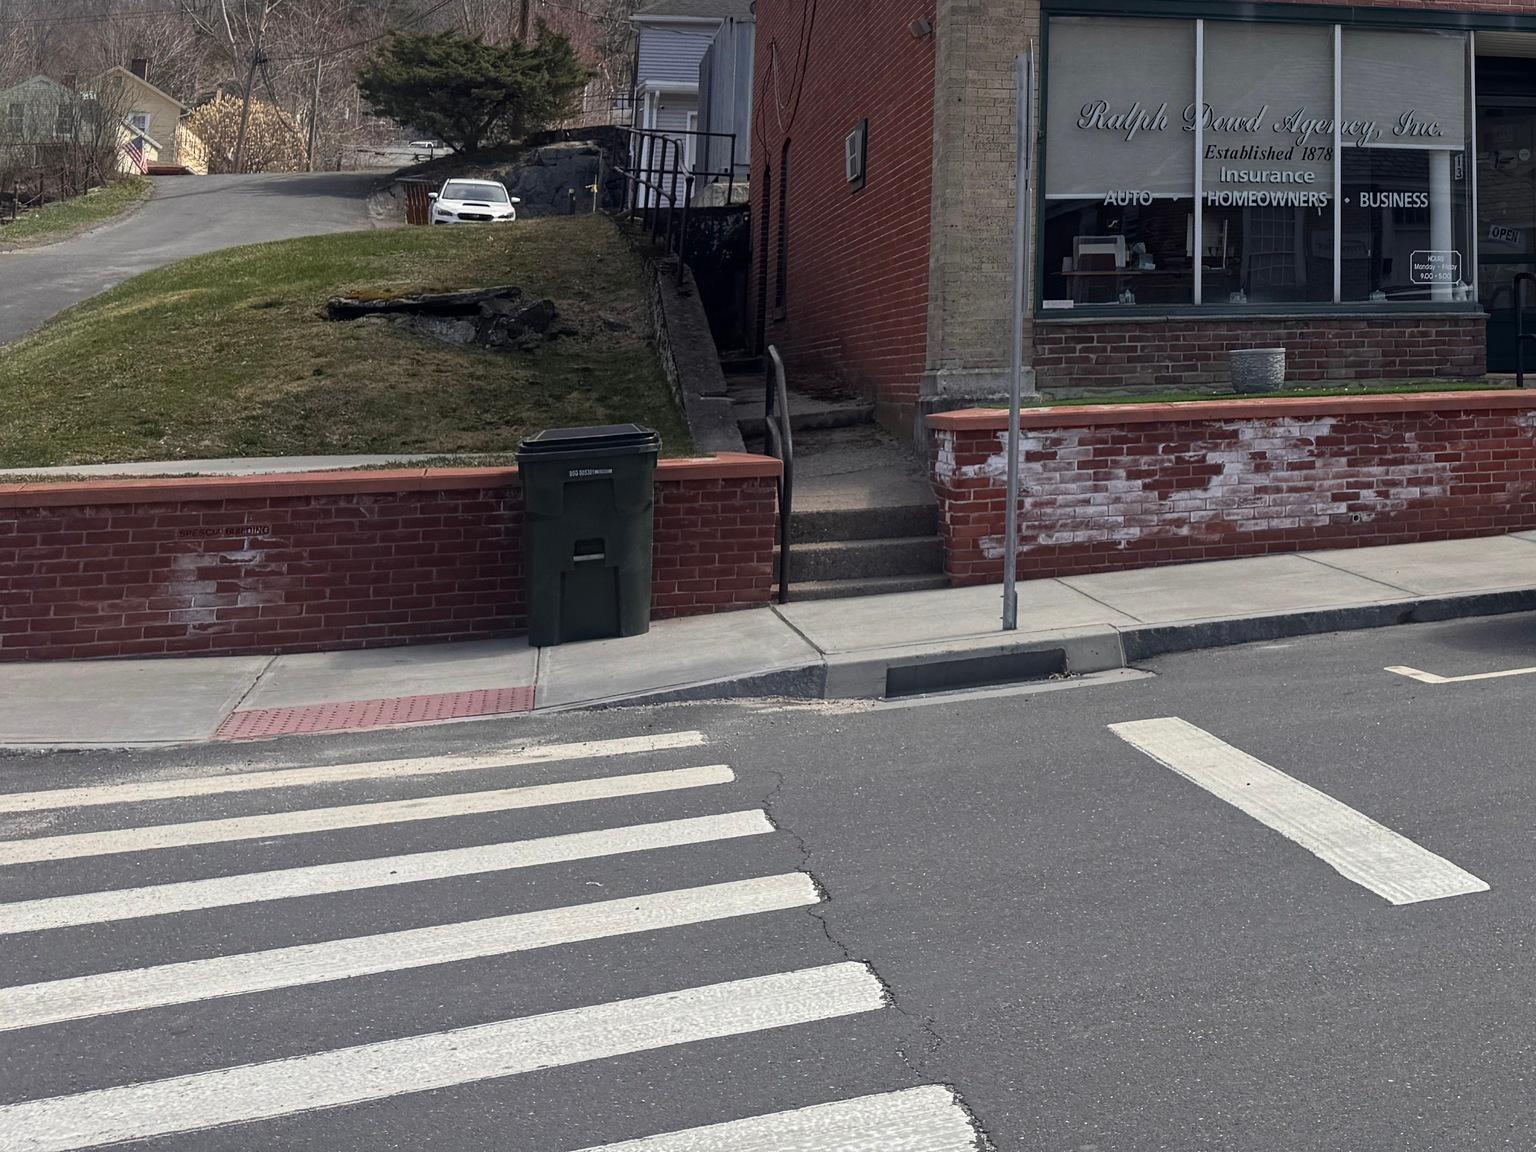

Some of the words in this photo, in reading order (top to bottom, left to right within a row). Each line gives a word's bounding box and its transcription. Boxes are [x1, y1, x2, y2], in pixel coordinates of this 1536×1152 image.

[1077, 100, 1168, 141] Ralph
[1182, 104, 1268, 135] Dowd
[1273, 105, 1383, 147] Agency,
[1392, 108, 1445, 137] Inc.
[1204, 144, 1298, 163] Established
[1301, 146, 1334, 163] 1878
[1220, 166, 1315, 185] Insurance
[1104, 190, 1153, 207] AUTO
[1207, 190, 1328, 208] HOMEOWNERS
[1359, 192, 1429, 209] BUSINESS
[1492, 228, 1520, 243] OPEN
